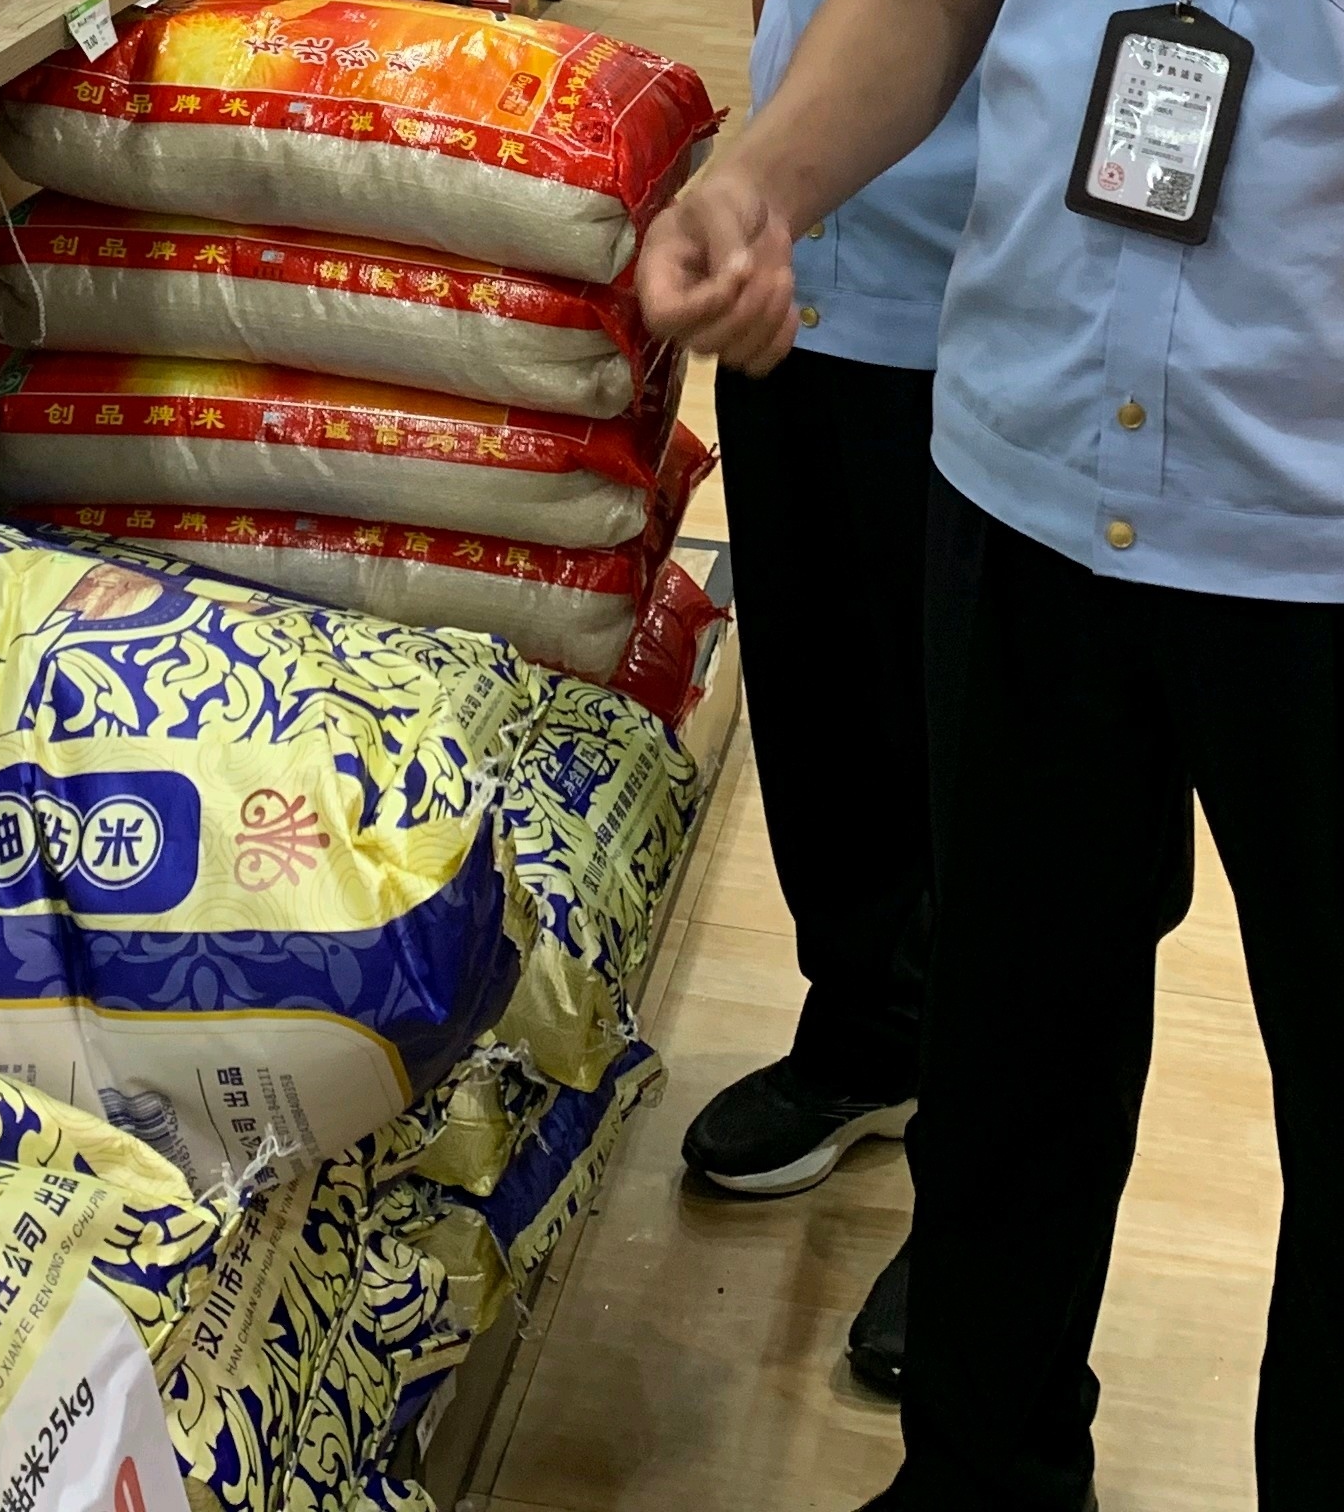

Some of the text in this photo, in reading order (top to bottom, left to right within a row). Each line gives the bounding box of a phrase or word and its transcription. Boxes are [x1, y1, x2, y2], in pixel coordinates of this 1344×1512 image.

[72, 78, 529, 166] 创品牌米 诚信为民
[47, 234, 503, 308] 创品牌米 诚信为民
[42, 401, 507, 460] 创品牌米 诚信为民
[74, 504, 532, 570] 创品牌米 诚信为民
[34, 1174, 81, 1219] 出品
[28, 1285, 54, 1318] REN
[45, 1253, 66, 1287] GONG
[61, 1237, 75, 1255] SI
[72, 1208, 97, 1239] CHU
[92, 1187, 108, 1212] PIN
[225, 1343, 244, 1376] HAN
[237, 1299, 259, 1344] CHUAN
[254, 1275, 266, 1299] SHI
[260, 1249, 276, 1276] HUA
